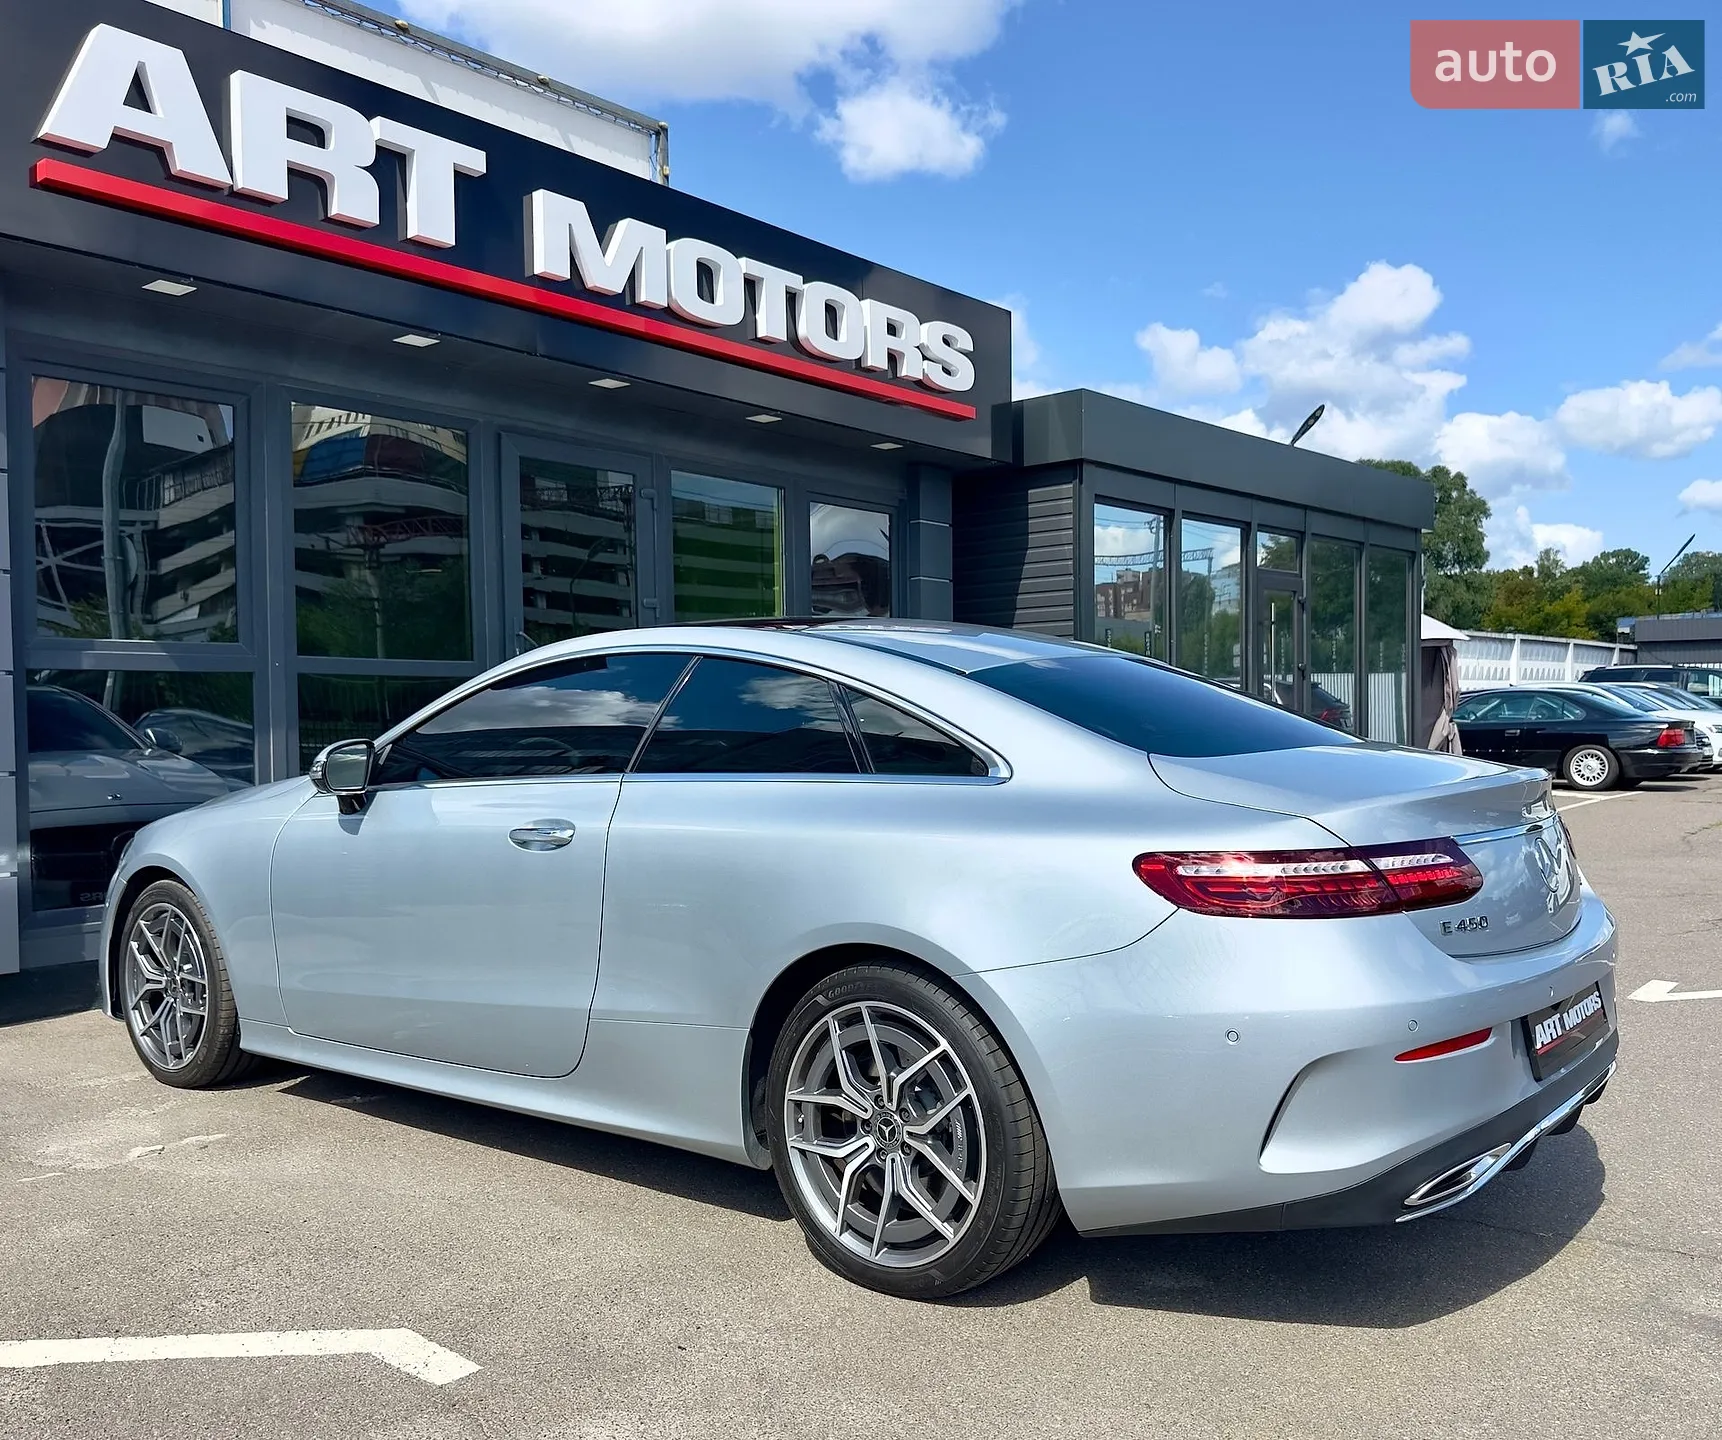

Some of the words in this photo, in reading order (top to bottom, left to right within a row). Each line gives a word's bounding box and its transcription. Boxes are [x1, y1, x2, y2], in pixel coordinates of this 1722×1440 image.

[33, 22, 487, 249] ART
[530, 188, 977, 393] MOTORS
[1440, 921, 1453, 936] E
[1455, 915, 1489, 932] 450
[1534, 1012, 1563, 1049] ART
[1562, 991, 1602, 1031] MOTORS
